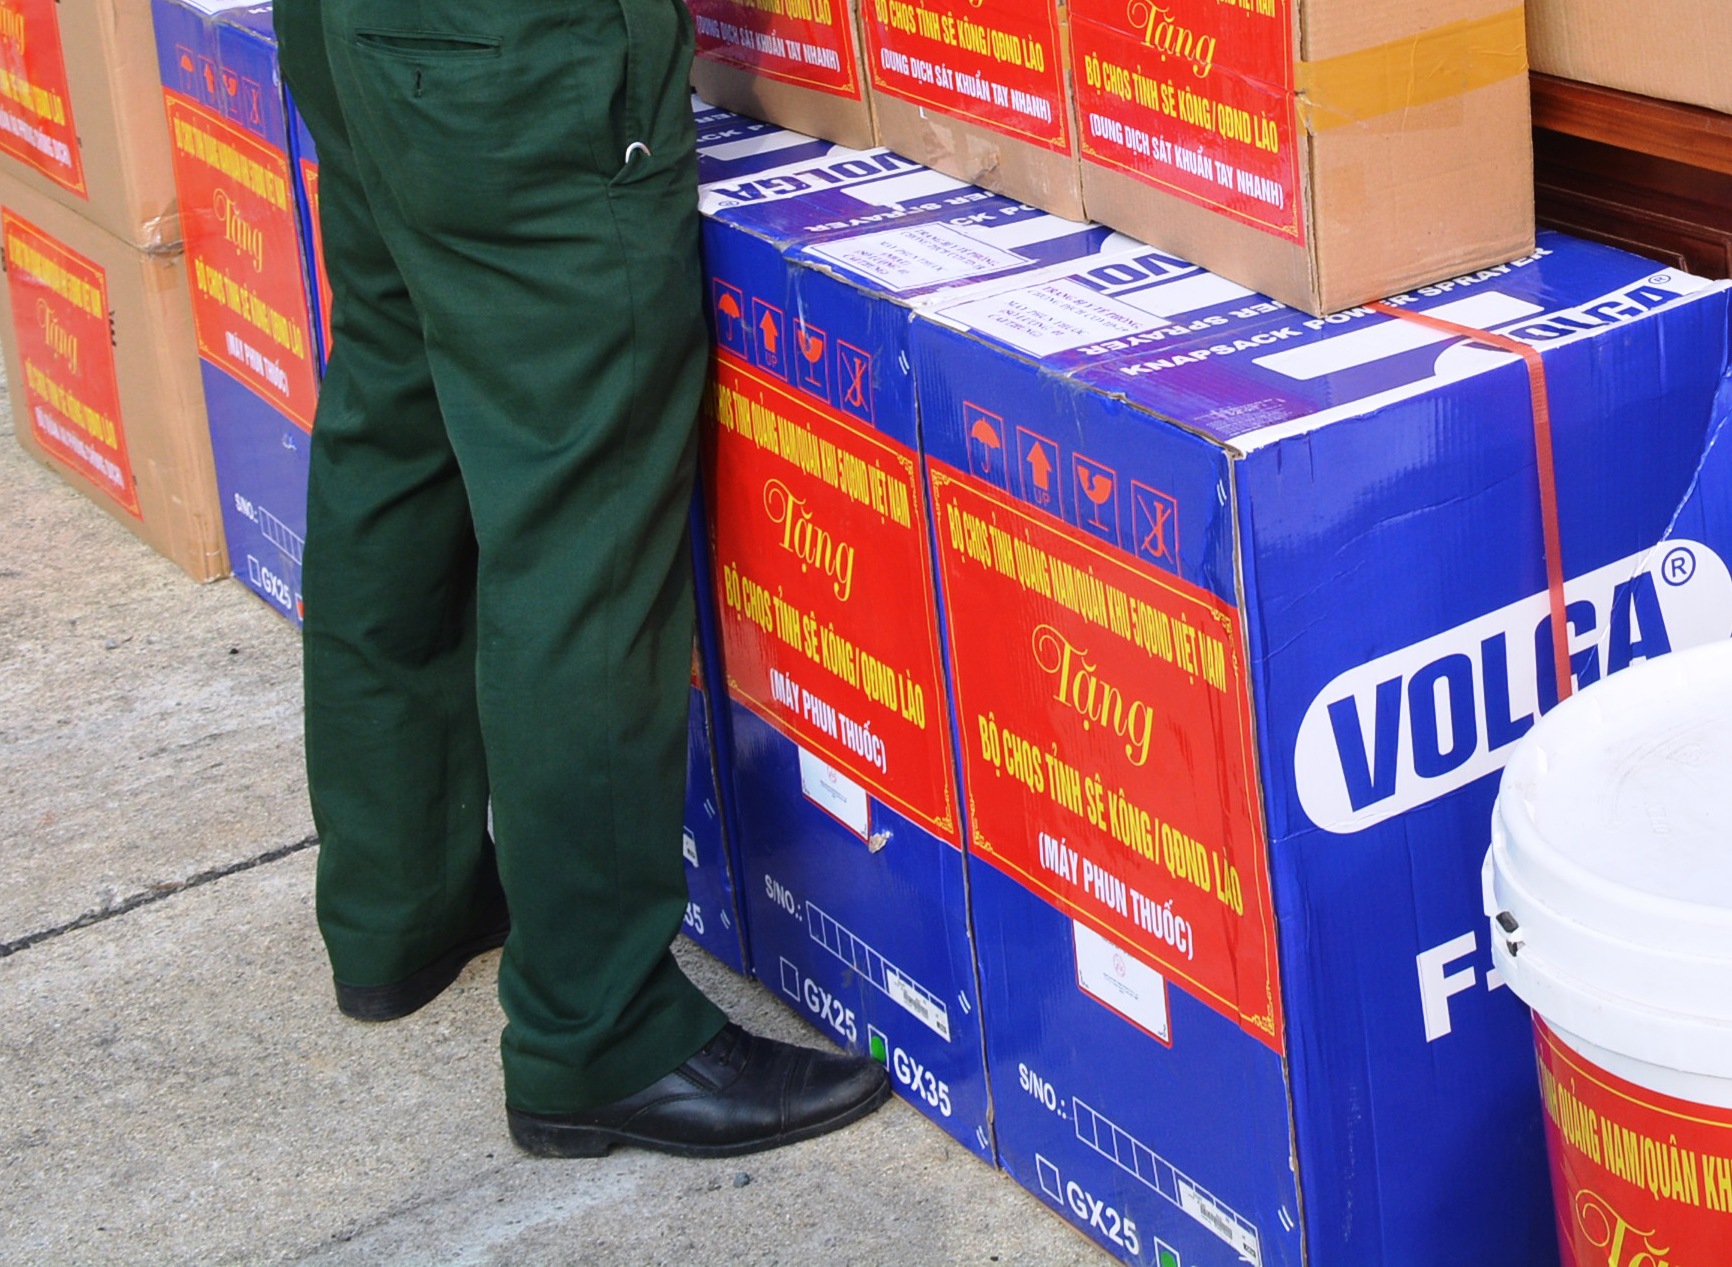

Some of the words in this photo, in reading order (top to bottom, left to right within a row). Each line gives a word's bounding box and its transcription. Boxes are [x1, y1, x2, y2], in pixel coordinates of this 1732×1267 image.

[1089, 113, 1124, 145] (DUNG
[1124, 125, 1151, 157] DỊCH
[1151, 135, 1173, 165] SÁT
[1174, 144, 1214, 182] KHUẨN
[1214, 160, 1234, 190] TAY
[1236, 168, 1284, 210] NHANH)
[1077, 315, 1224, 355] SPRAYER
[1120, 324, 1305, 377] KNAPSACK
[261, 566, 292, 610] GX25
[1326, 569, 1673, 812] VOLGA
[1038, 831, 1078, 886] (MÁY
[1082, 857, 1128, 918] PHUN
[1129, 888, 1194, 960] THUỐC)
[803, 977, 858, 1042] GX25
[893, 1047, 952, 1117] GX35
[1066, 1181, 1140, 1255] GX25
